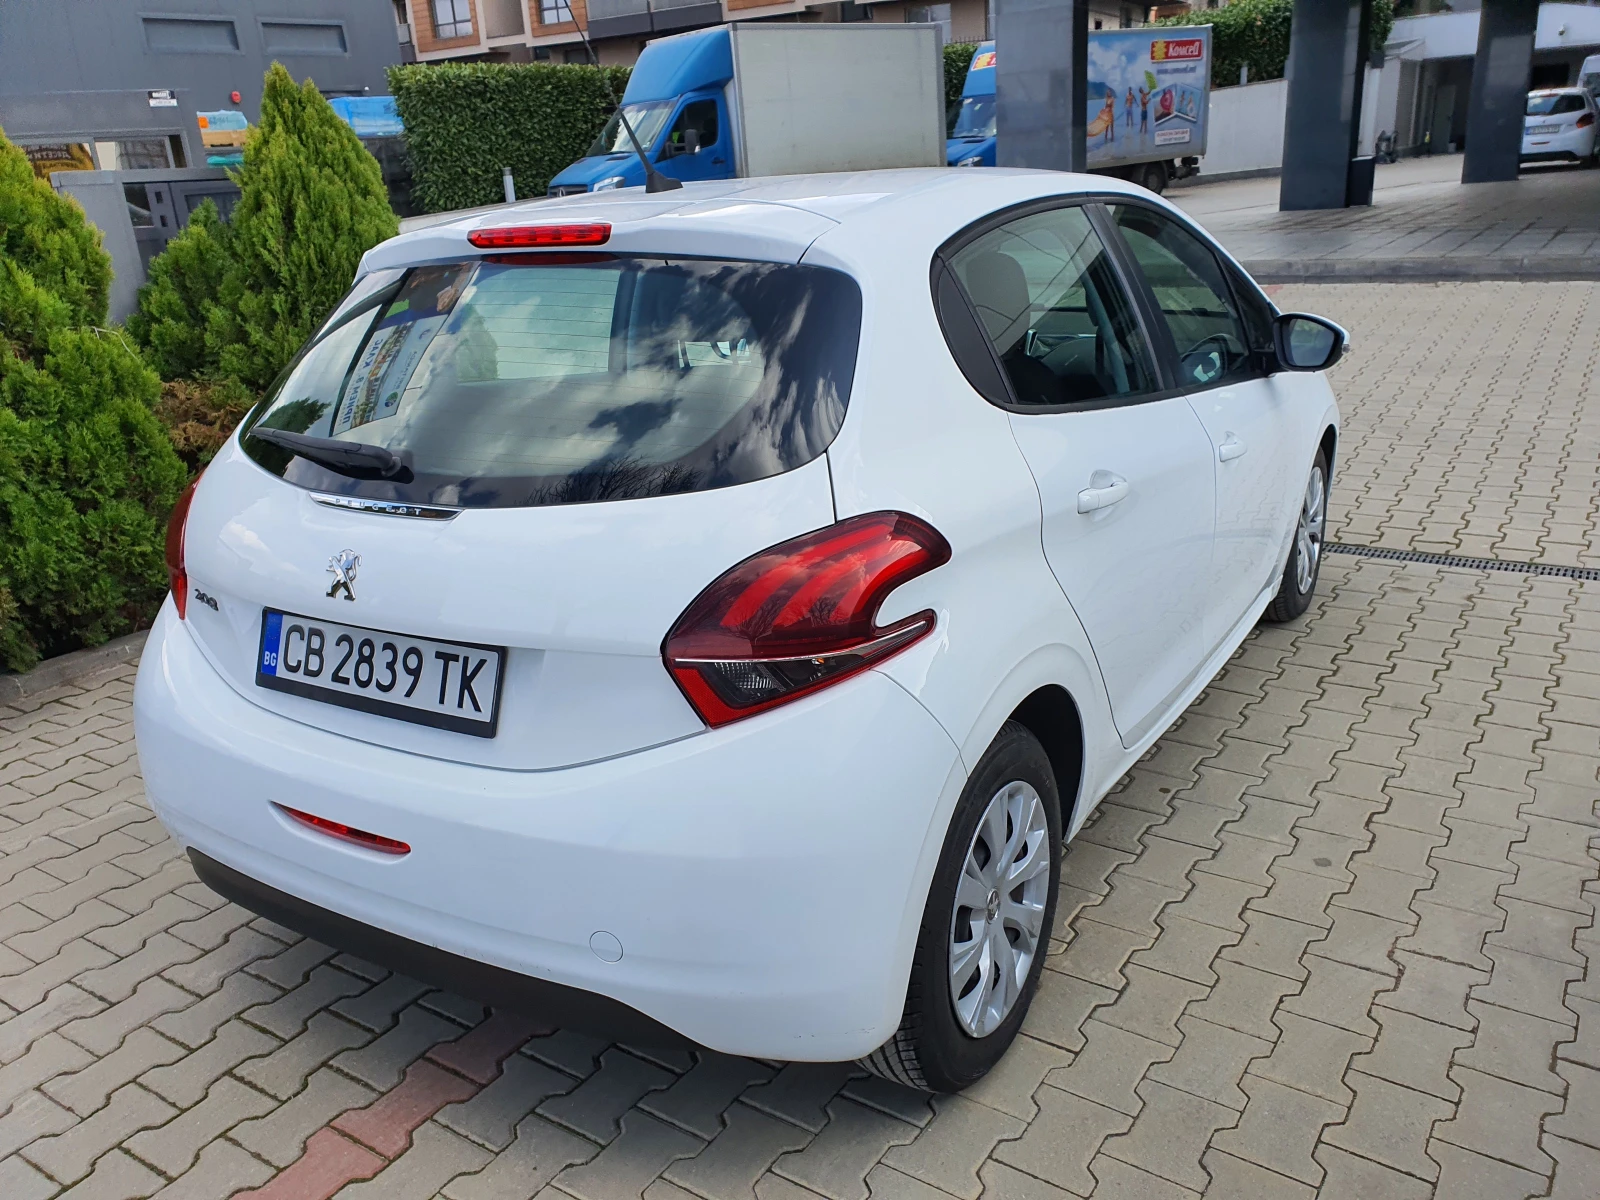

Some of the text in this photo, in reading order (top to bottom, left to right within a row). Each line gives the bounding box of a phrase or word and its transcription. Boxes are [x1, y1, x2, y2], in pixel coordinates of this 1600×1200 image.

[335, 498, 422, 516] PEUGEOT
[194, 588, 219, 612] 208
[263, 650, 277, 667] BG
[283, 623, 488, 713] CB 2839 TK
